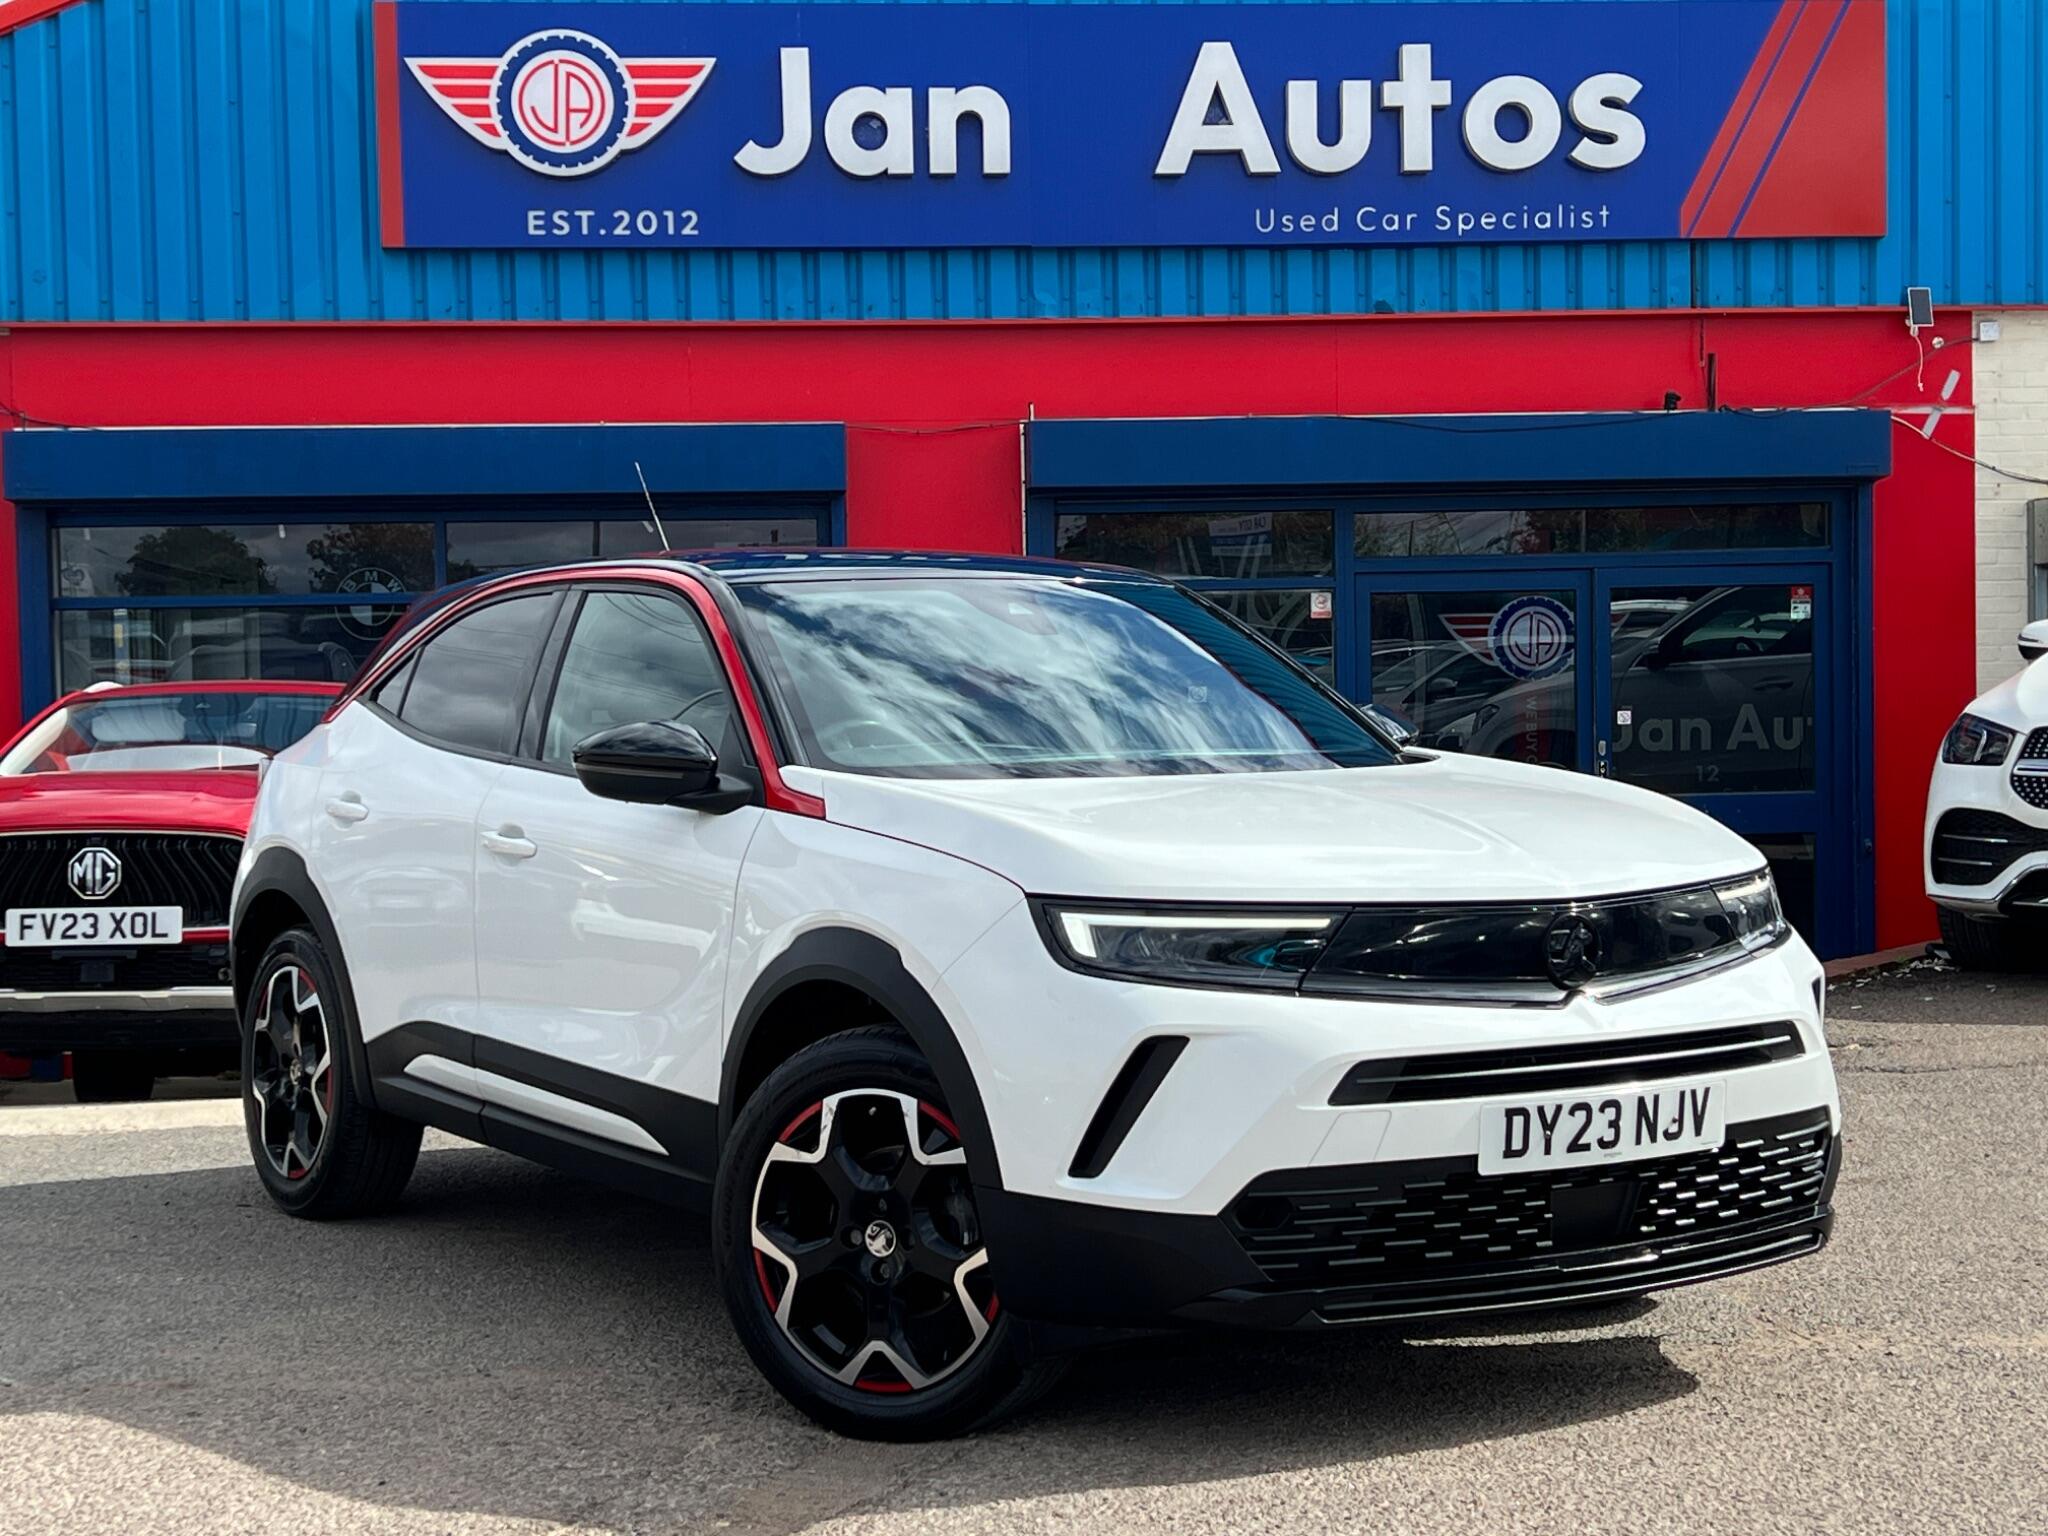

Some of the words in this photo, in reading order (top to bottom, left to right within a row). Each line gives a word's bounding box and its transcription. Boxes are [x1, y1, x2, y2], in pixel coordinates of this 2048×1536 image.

[733, 46, 1011, 177] Jan
[1154, 41, 1647, 177] Autos
[527, 209, 700, 236] EST.2012
[1255, 206, 1340, 233] Used
[1355, 206, 1418, 232] Car
[1434, 204, 1611, 236] Specialist
[341, 570, 402, 593] BMW
[1726, 703, 1814, 751] Au
[72, 850, 117, 895] MG
[19, 913, 100, 940] FV23
[109, 911, 169, 939] XOL
[1502, 1098, 1622, 1159] DY23
[1634, 1086, 1711, 1146] NJV
